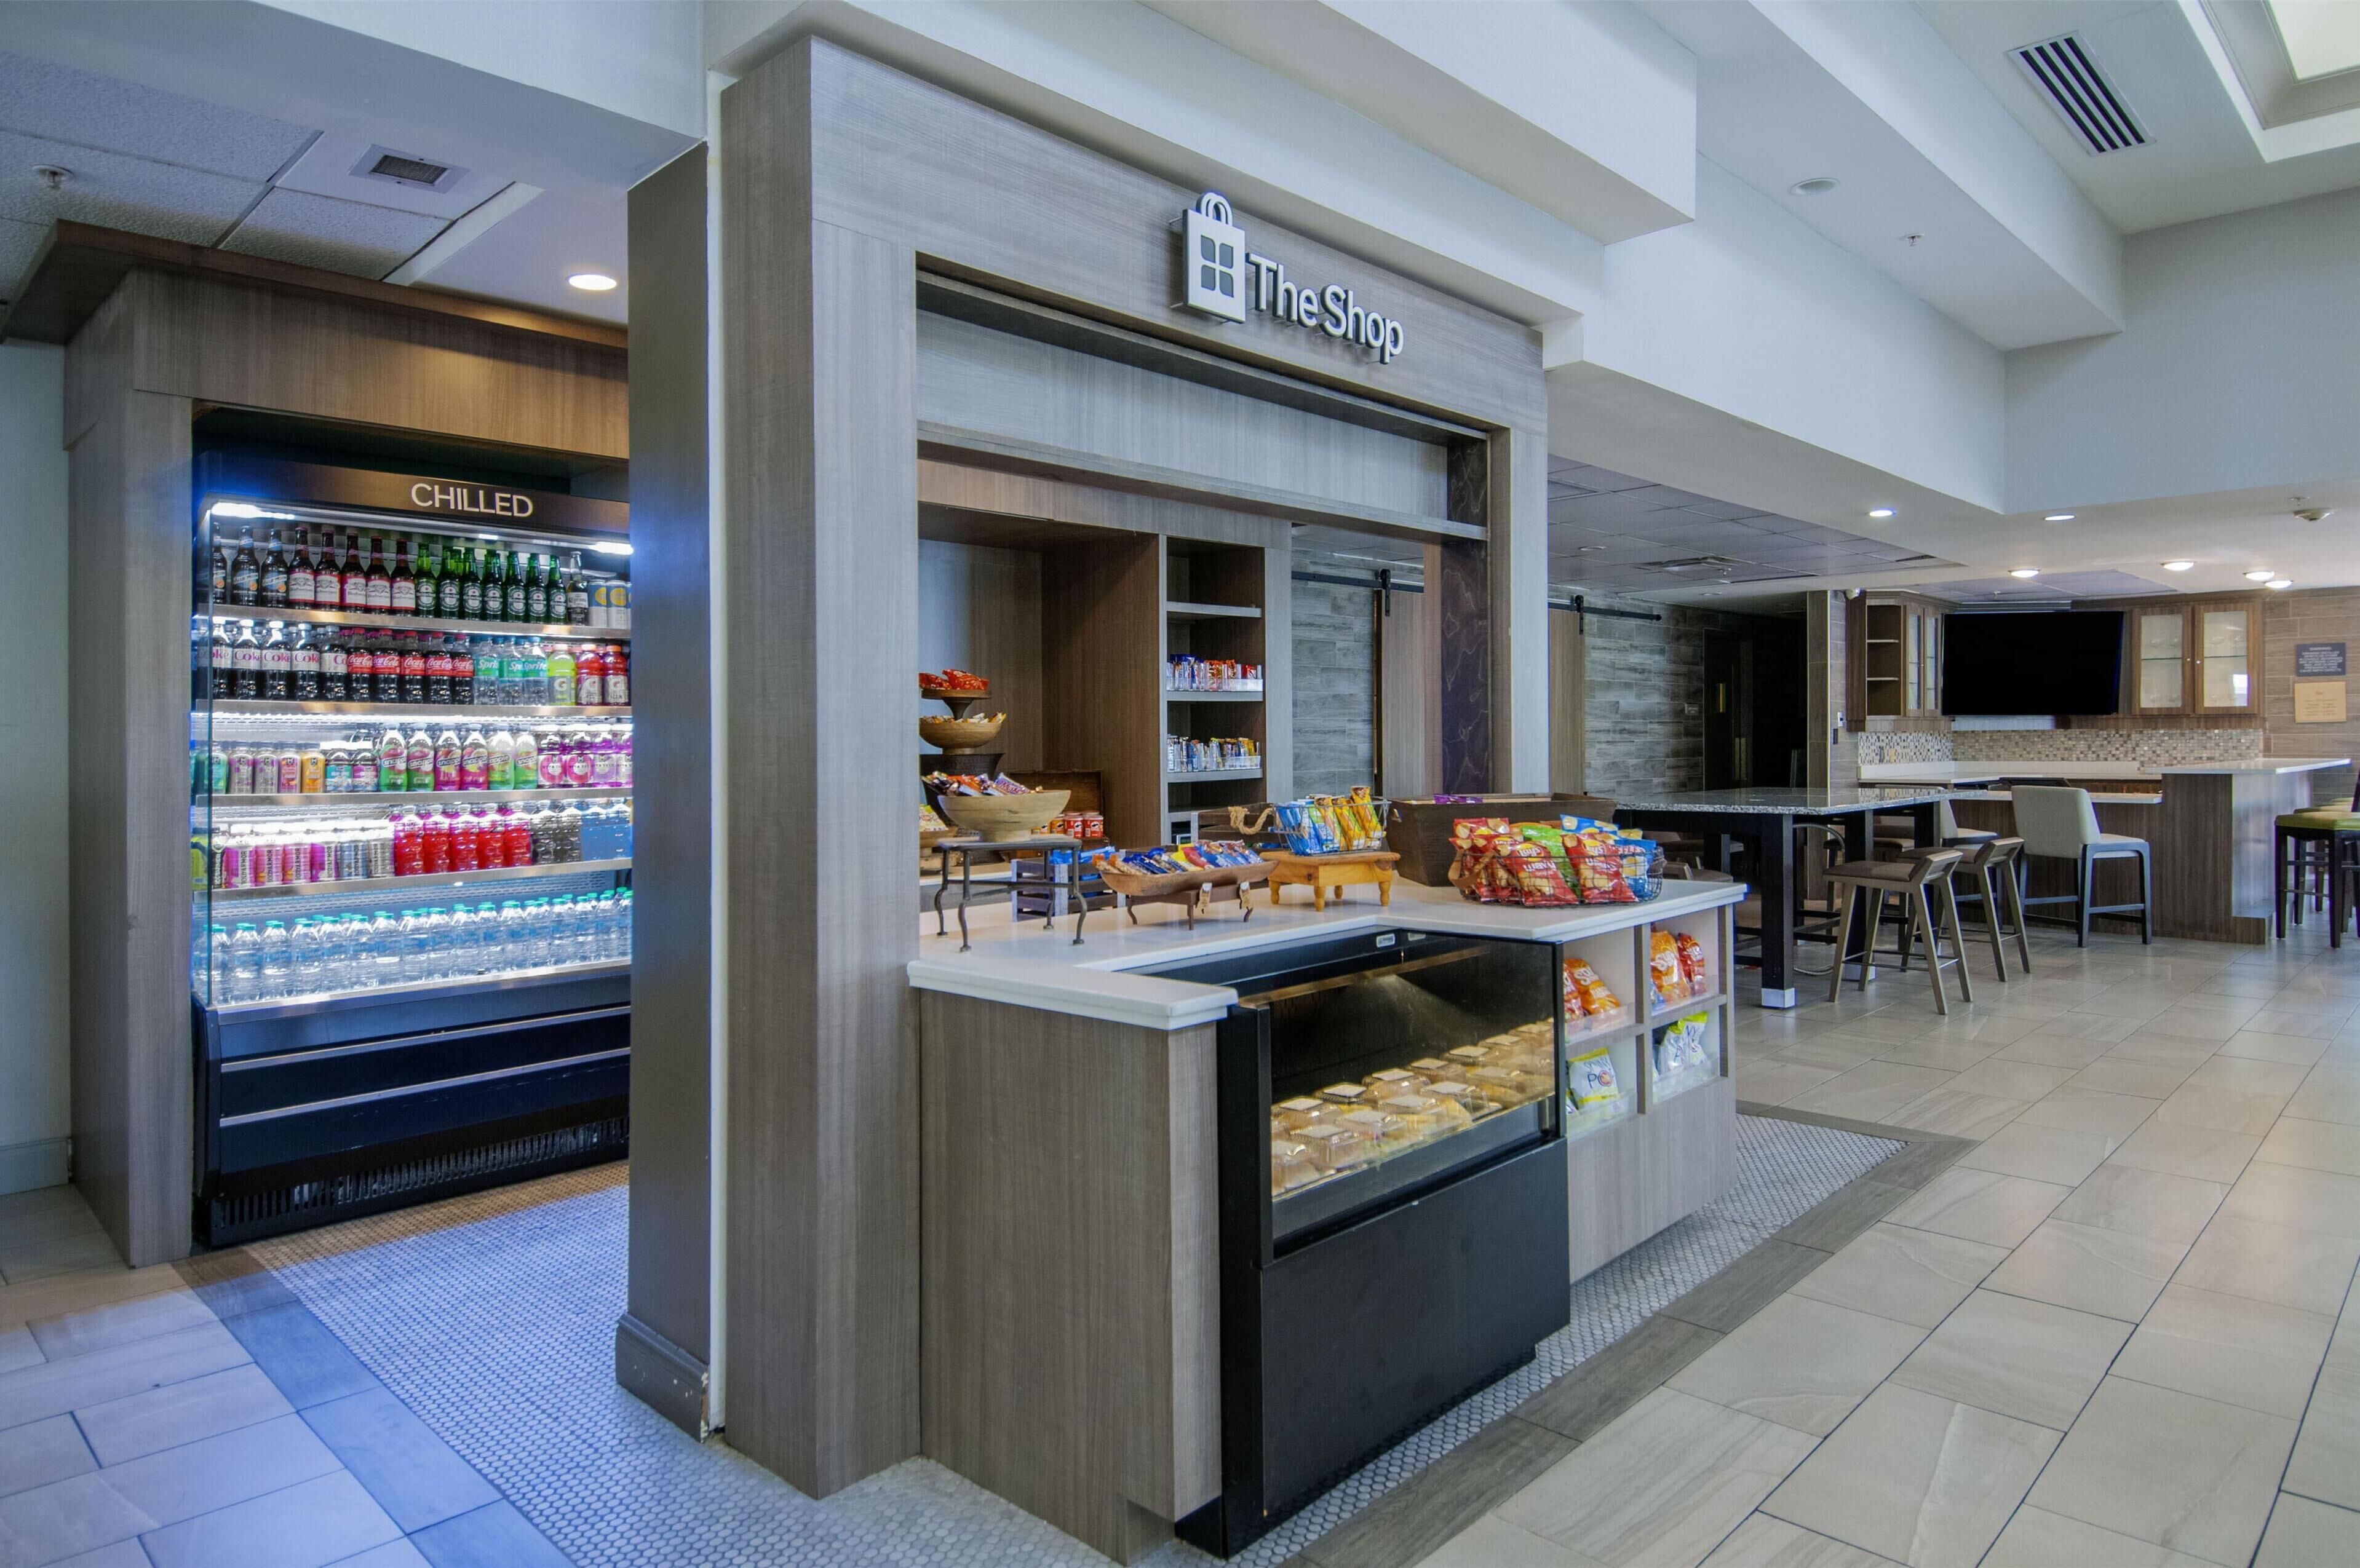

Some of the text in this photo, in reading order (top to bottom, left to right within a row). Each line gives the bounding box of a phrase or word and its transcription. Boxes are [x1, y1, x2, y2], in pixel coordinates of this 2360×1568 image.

[411, 483, 533, 517] CHILLED
[333, 654, 348, 665] Co
[477, 659, 499, 670] Spri
[523, 662, 547, 671] Sprite
[437, 757, 461, 766] snapp
